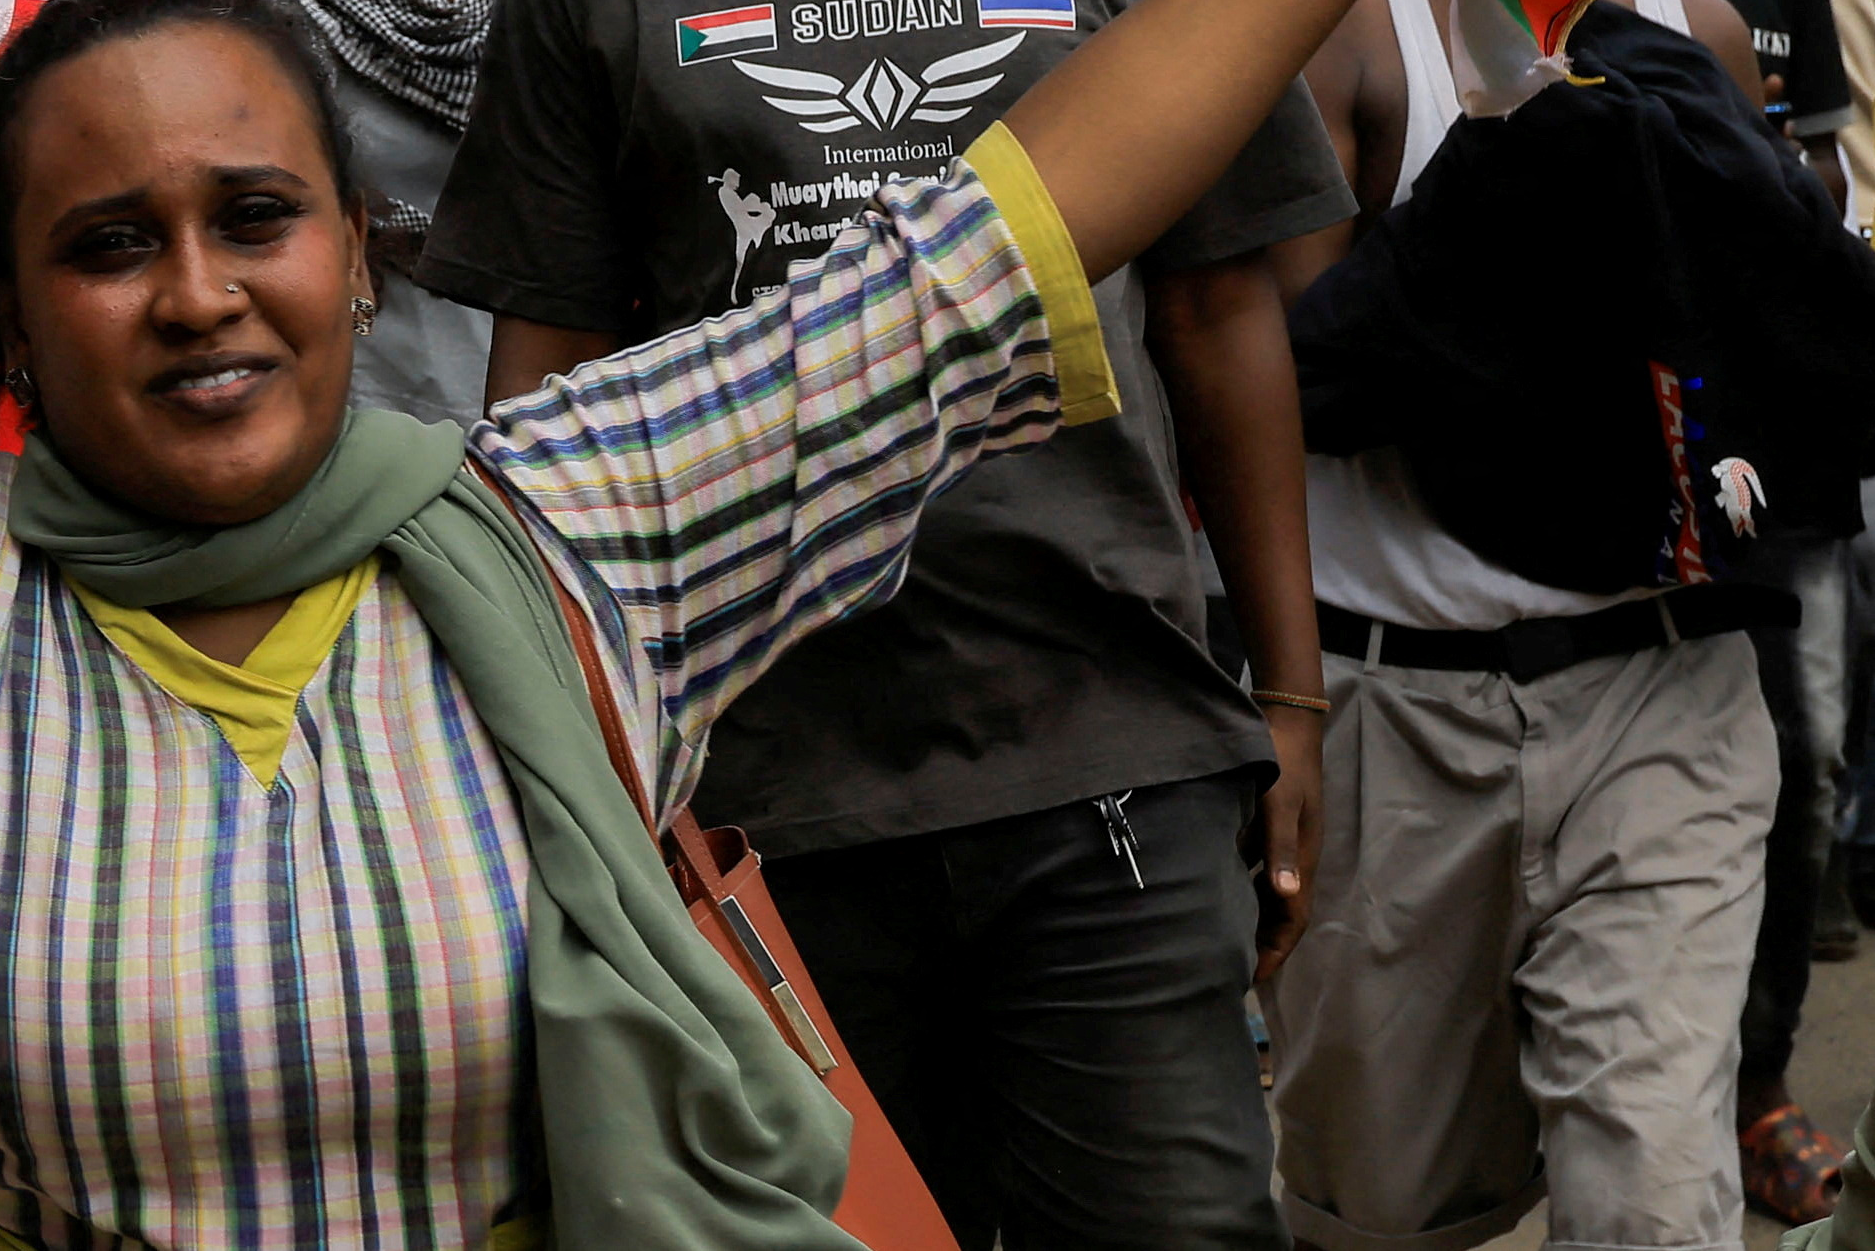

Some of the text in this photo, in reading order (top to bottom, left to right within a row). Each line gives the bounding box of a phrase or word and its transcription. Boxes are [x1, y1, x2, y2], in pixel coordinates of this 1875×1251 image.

[824, 136, 953, 165] International
[771, 170, 881, 209] Muaythai
[774, 216, 854, 246] Khart
